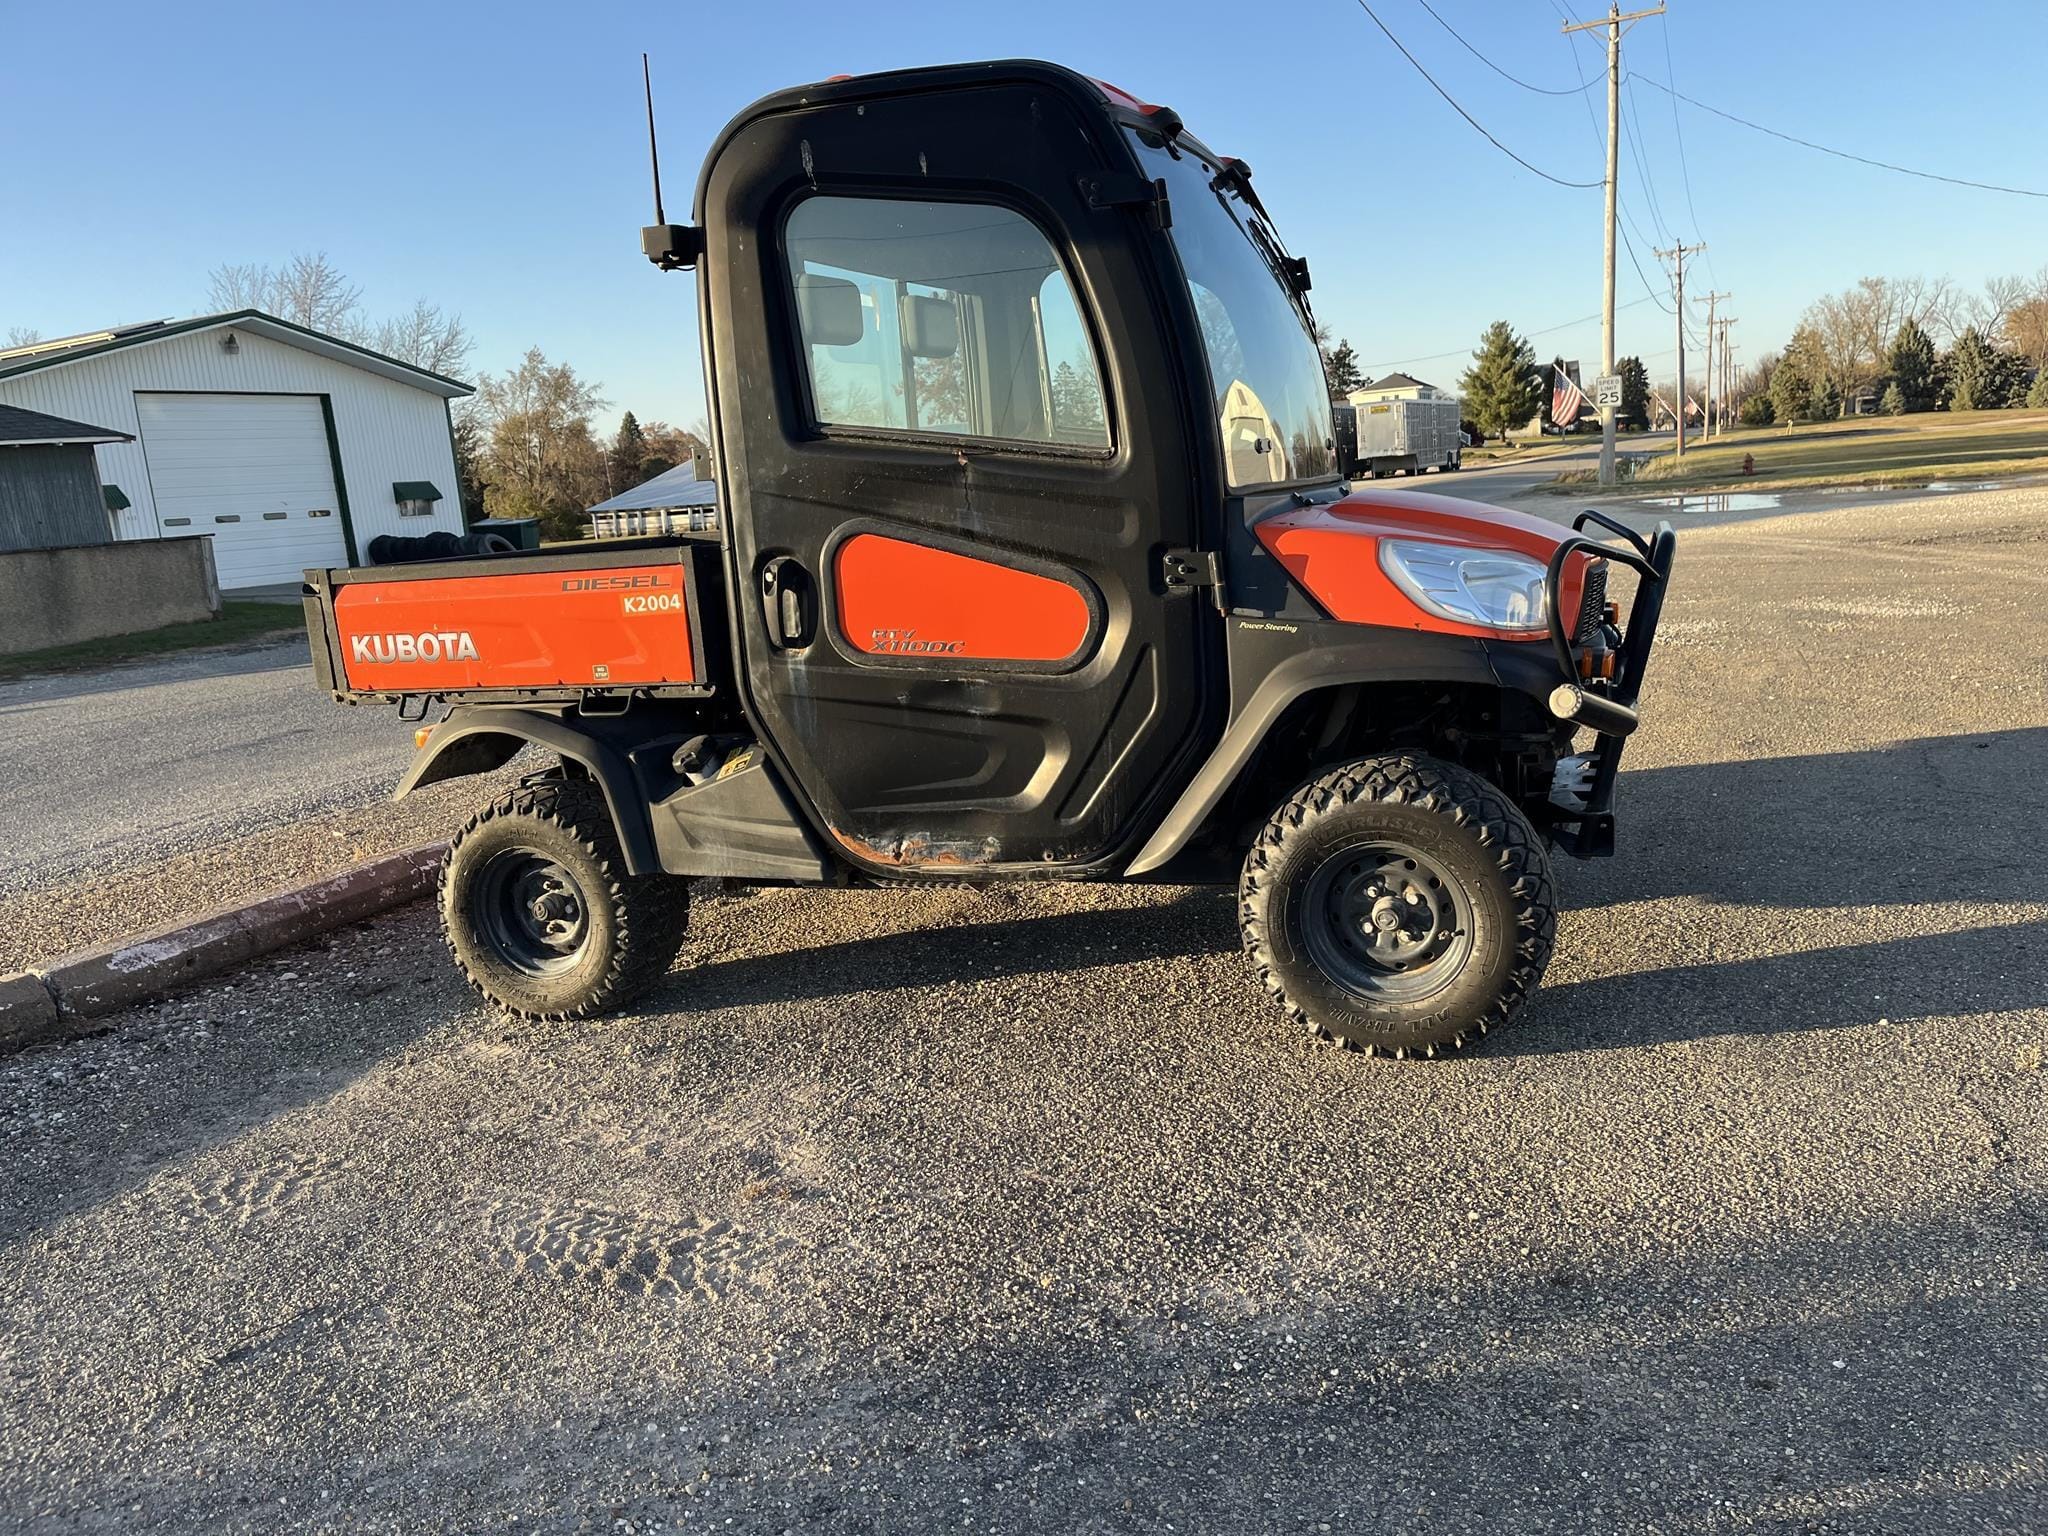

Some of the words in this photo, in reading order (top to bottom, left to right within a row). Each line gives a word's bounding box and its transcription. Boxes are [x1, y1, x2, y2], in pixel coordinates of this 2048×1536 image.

[1598, 378, 1619, 386] SPEED
[1599, 391, 1619, 404] 25
[562, 575, 671, 591] DIESEL
[623, 594, 681, 613] K2004
[871, 628, 917, 640] RTV
[1239, 621, 1264, 630] Power
[1264, 623, 1298, 634] Steering
[350, 630, 481, 664] KUBOTA
[869, 639, 966, 654] X1100C
[1405, 1007, 1450, 1033] ALL
